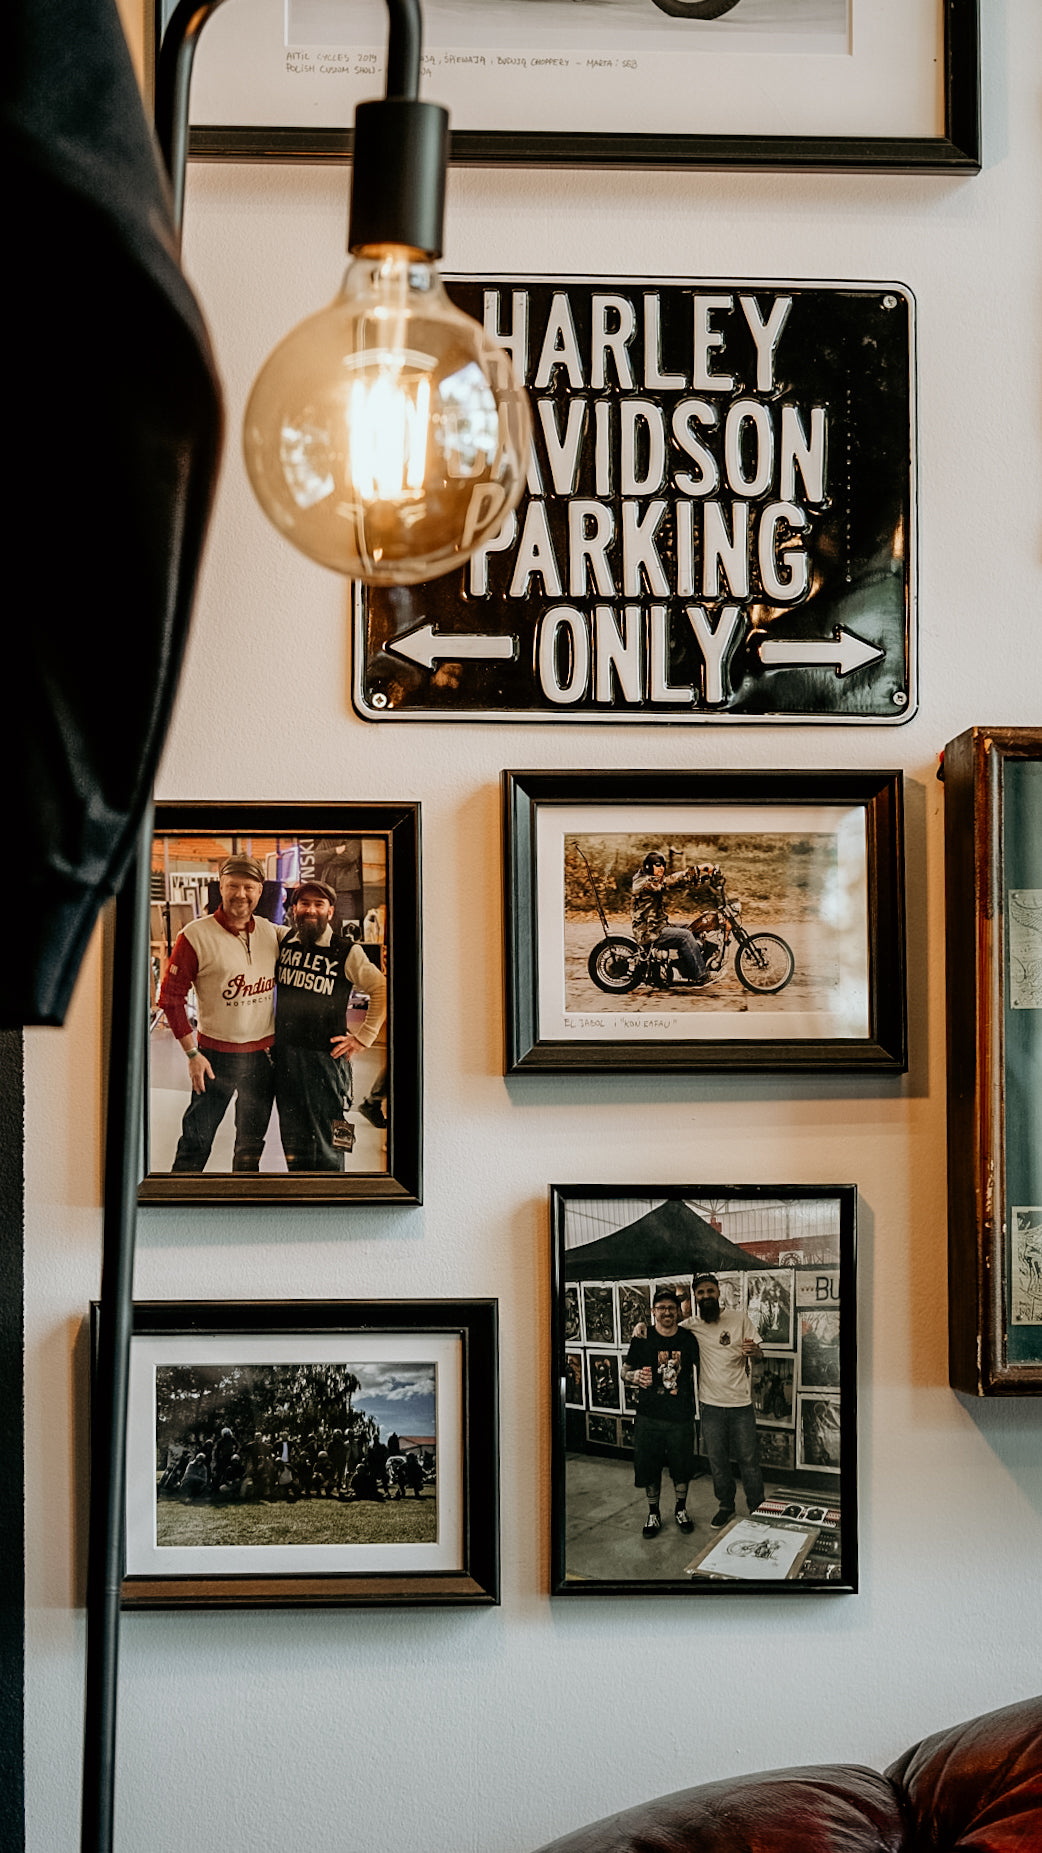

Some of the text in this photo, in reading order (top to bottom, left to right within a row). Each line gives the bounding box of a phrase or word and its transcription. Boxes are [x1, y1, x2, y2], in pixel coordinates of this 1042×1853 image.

[483, 288, 793, 393] HARLEY
[468, 499, 810, 601] PARKING
[538, 605, 742, 704] ONLY
